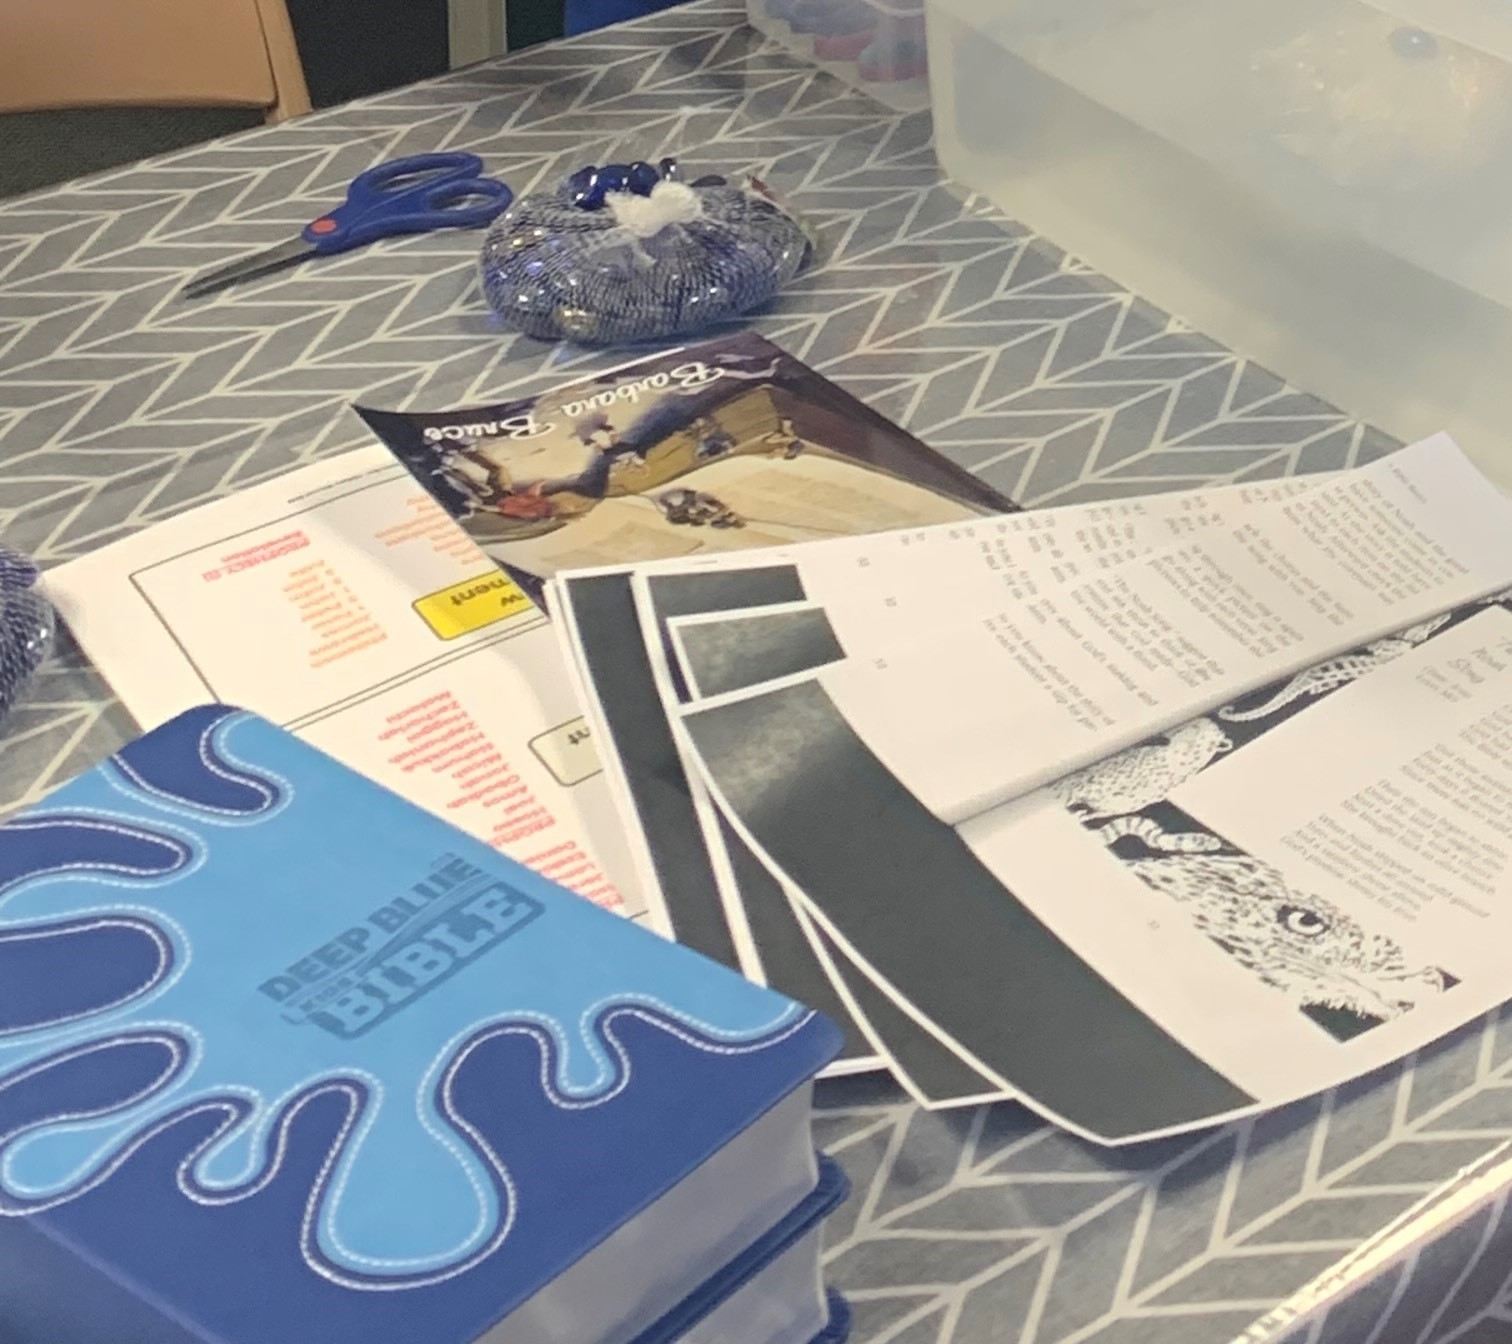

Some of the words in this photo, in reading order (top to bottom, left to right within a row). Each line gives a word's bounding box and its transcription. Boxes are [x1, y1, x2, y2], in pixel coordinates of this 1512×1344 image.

[424, 414, 555, 441] Bruce
[559, 361, 725, 417] Barbara
[257, 927, 371, 1002] DEEP
[368, 857, 483, 934] BLUE
[320, 886, 537, 1035] BIBLE
